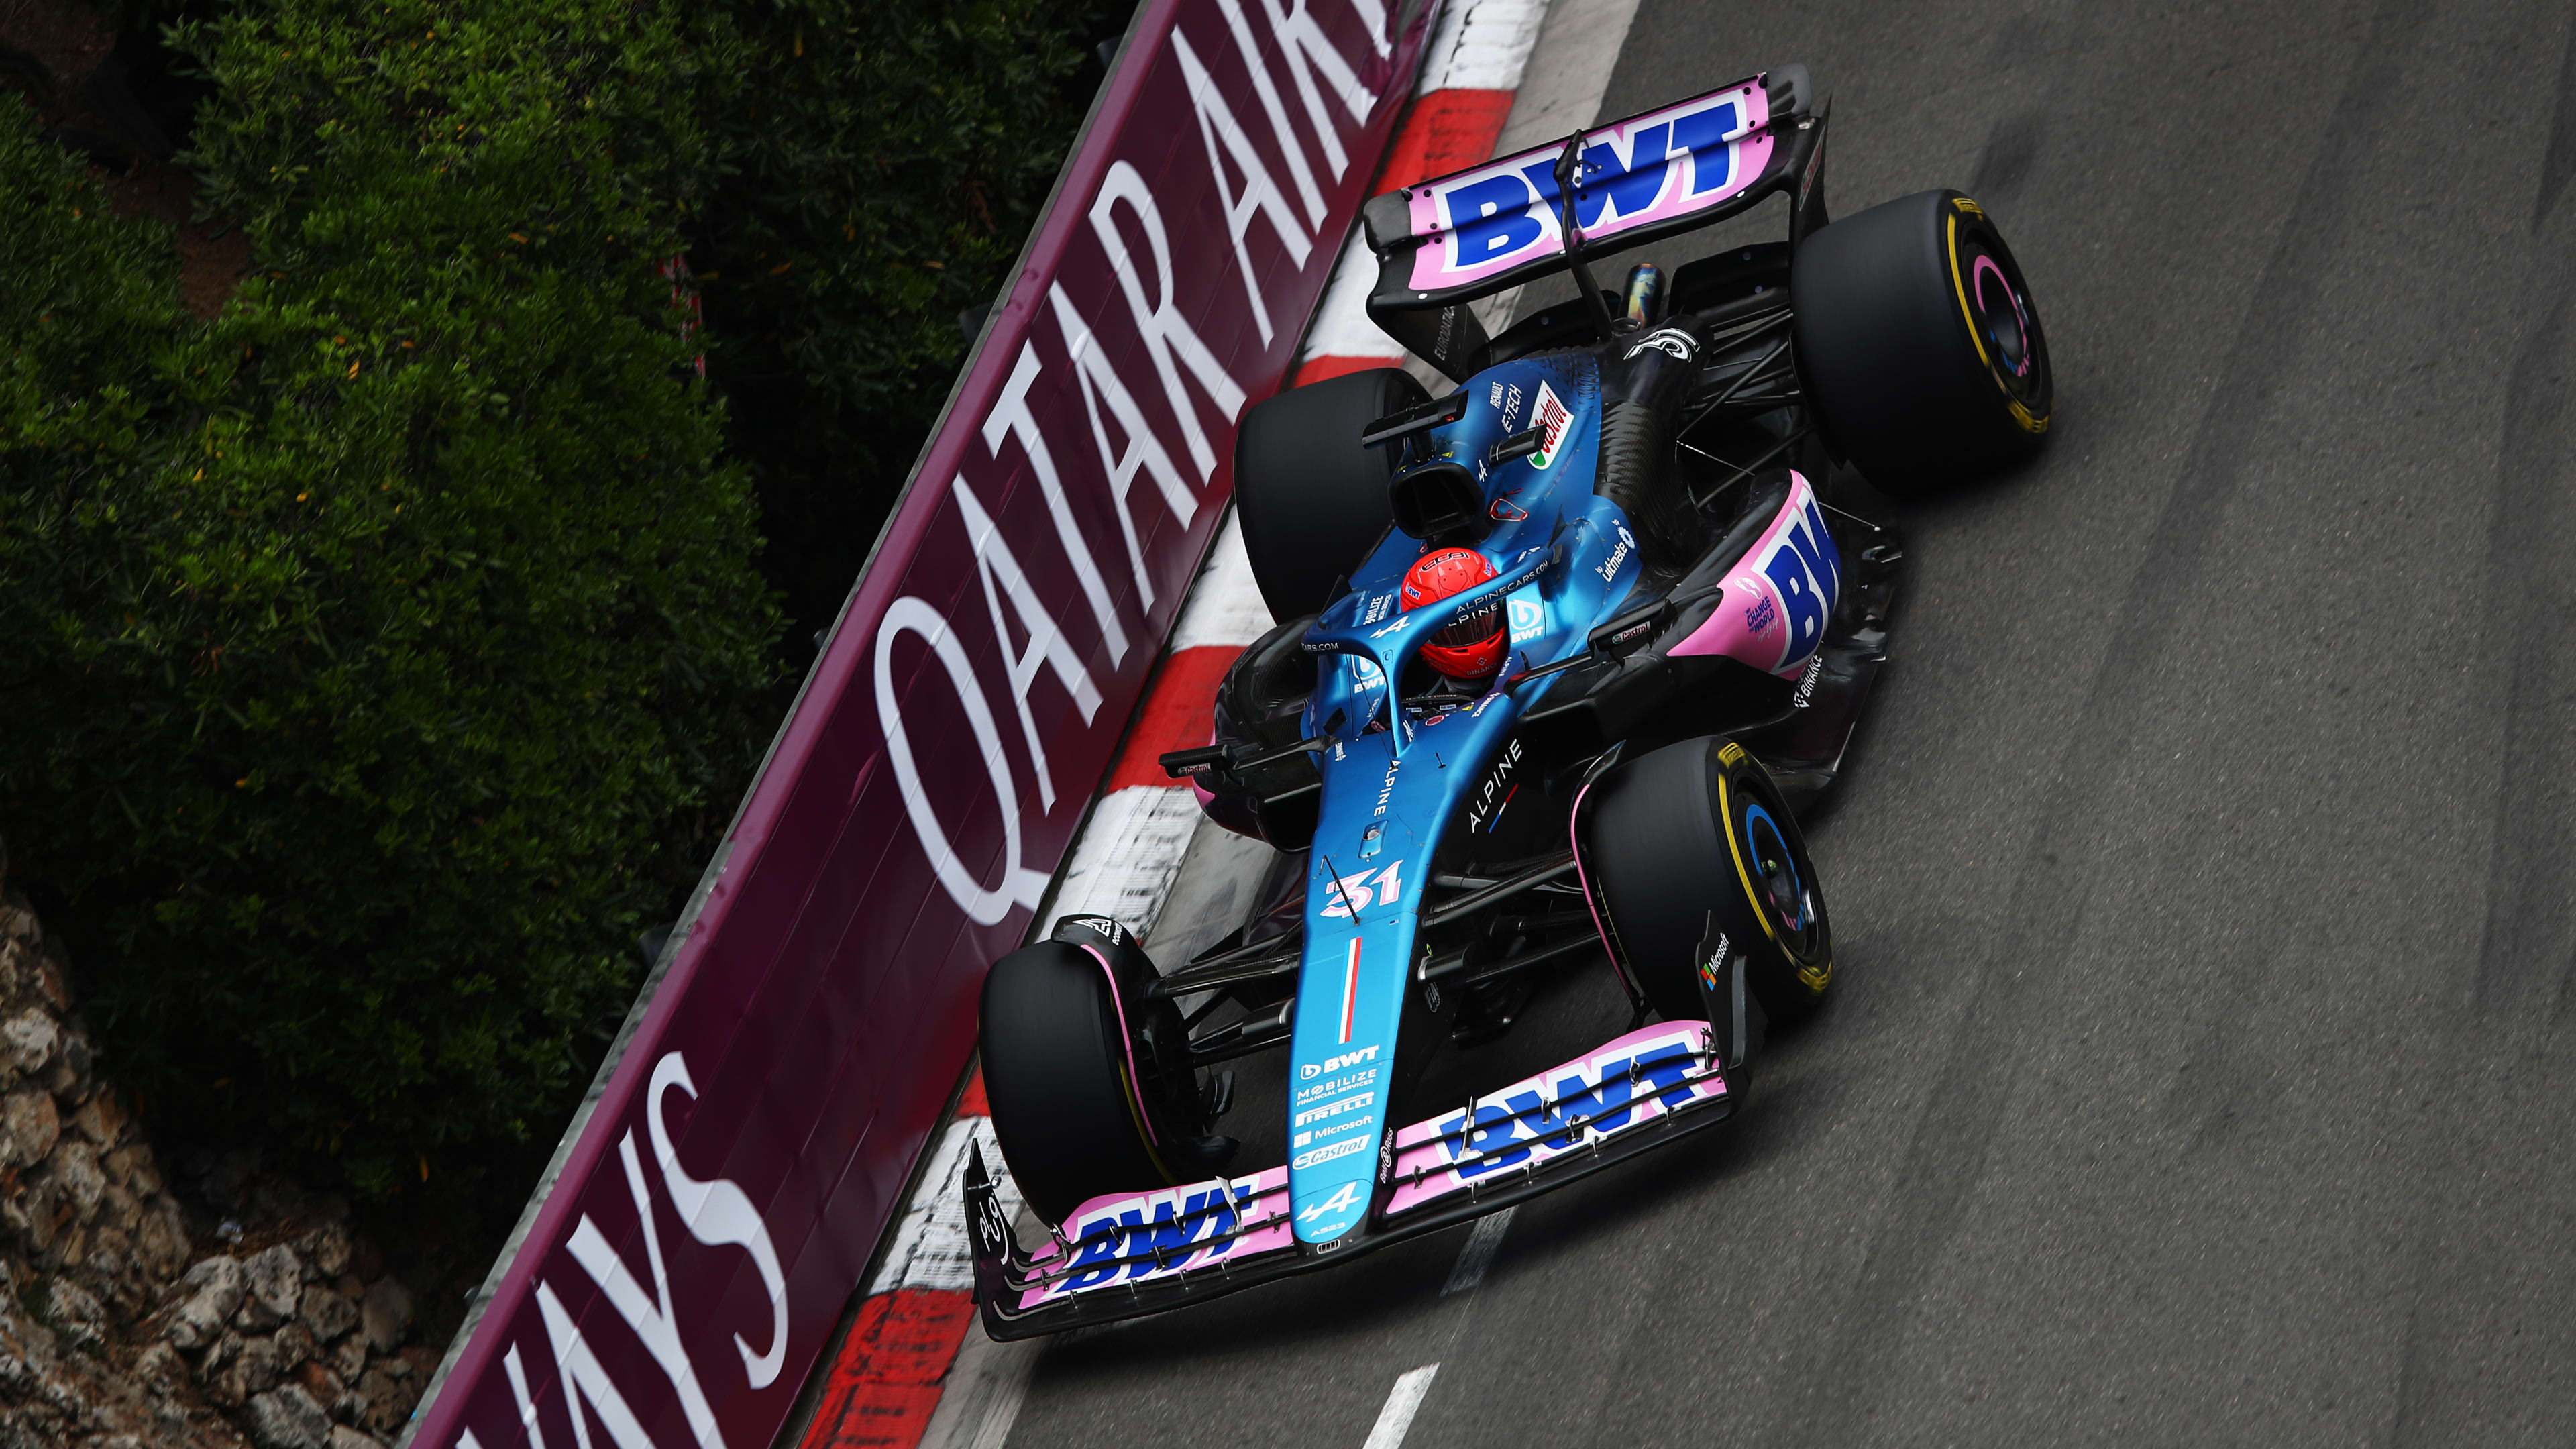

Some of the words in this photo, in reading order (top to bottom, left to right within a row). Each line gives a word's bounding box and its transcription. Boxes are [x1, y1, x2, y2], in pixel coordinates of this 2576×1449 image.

[1440, 98, 1742, 270] BWT
[1490, 381, 1503, 409] RENAULT
[874, 160, 1247, 925] QATAR
[1602, 541, 1627, 582] ultimate
[1456, 559, 1548, 614] ALPINECARS.COM
[1747, 596, 1771, 627] CHANGE
[1754, 608, 1774, 633] WORLD
[1511, 625, 1543, 644] BWT
[1621, 623, 1649, 641] Castrol
[1466, 661, 1497, 676] BINANCE
[1801, 655, 1823, 697] BINANCE
[1354, 676, 1385, 694] BWT
[1373, 760, 1401, 816] ALPINE
[1470, 738, 1522, 833] ALPINE
[1320, 859, 1404, 918] 31
[1709, 932, 1729, 975] Microsoft
[1324, 1044, 1379, 1073] BWT
[1296, 1090, 1336, 1107] FINANCIAL
[1338, 1079, 1373, 1093] SERVICES
[1295, 1091, 1375, 1127] PIRELLI
[1434, 1037, 1700, 1181] BWT
[1315, 1115, 1373, 1139] Microsoft
[1385, 1127, 1393, 1151] Ross
[1311, 1138, 1362, 1163] Castrol
[1049, 1181, 1254, 1296] BWT
[1311, 1222, 1346, 1237] A523
